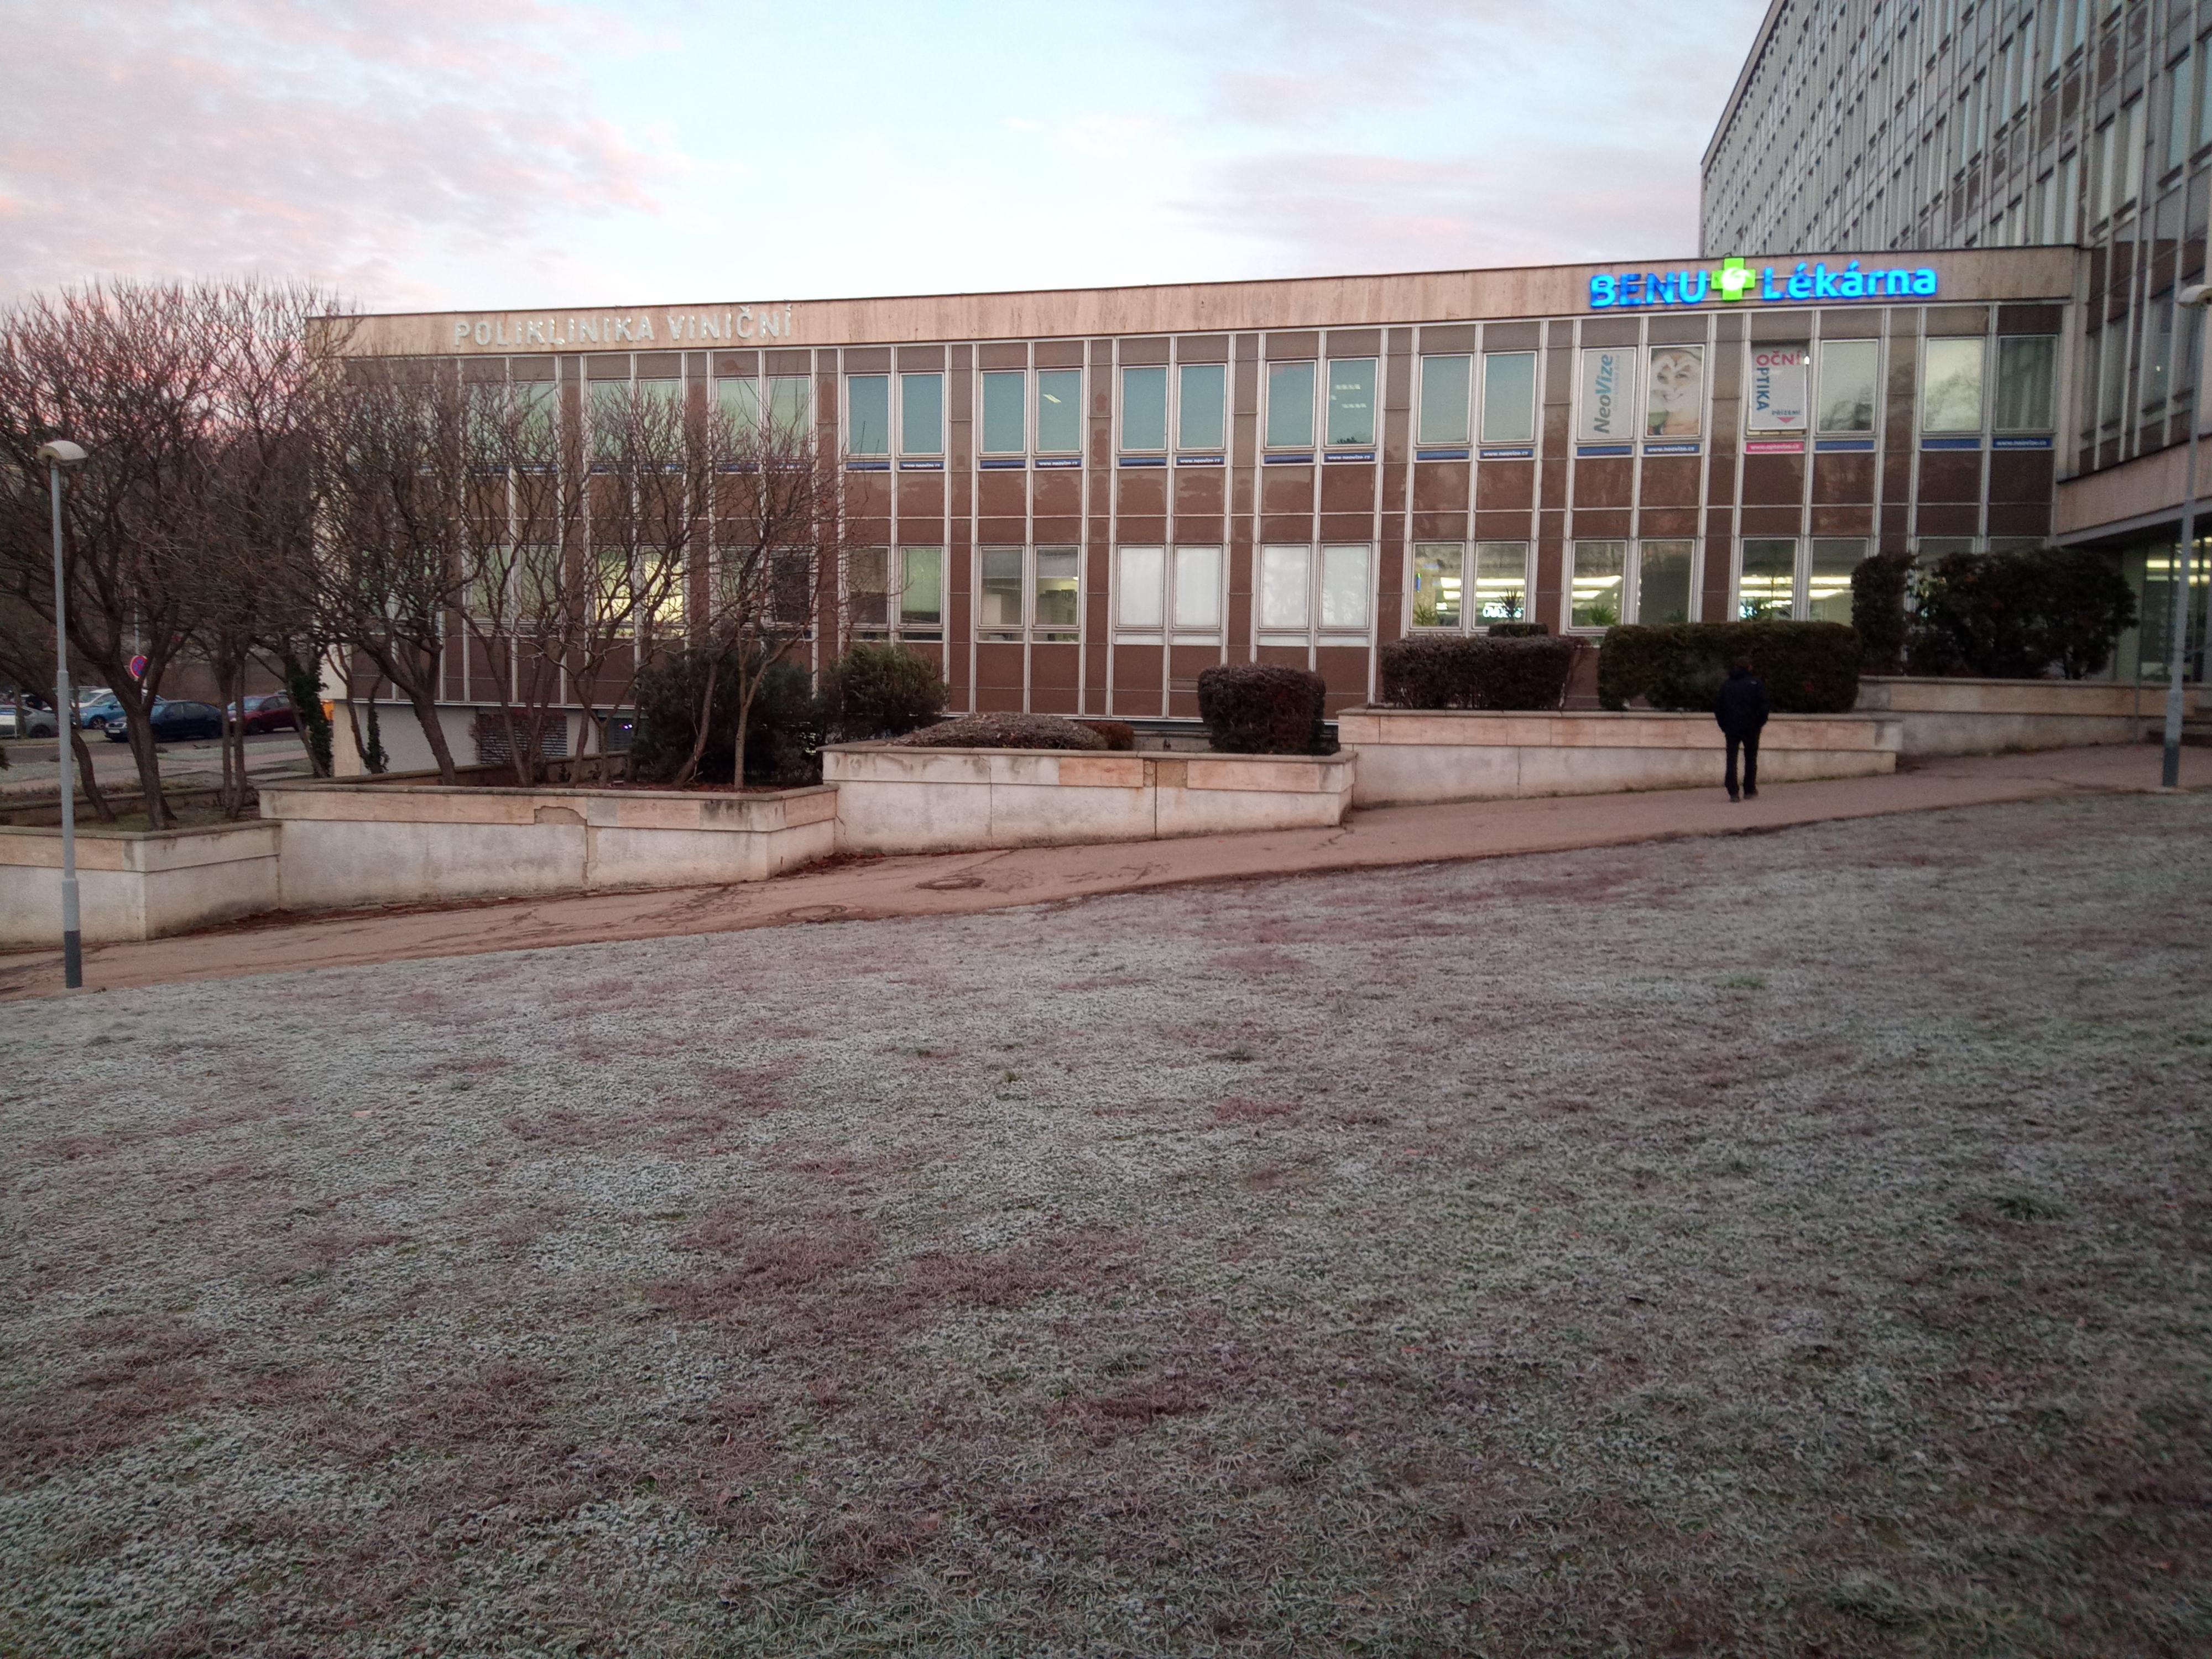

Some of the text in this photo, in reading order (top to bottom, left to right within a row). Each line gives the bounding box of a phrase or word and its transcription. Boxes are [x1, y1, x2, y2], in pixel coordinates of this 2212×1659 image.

[1590, 260, 1937, 307] BENU Lékárna
[453, 304, 792, 346] POLIKLINIKA VINIČNÍ
[1756, 349, 1802, 366] OČNÍ
[1593, 353, 1614, 434] NeoVize
